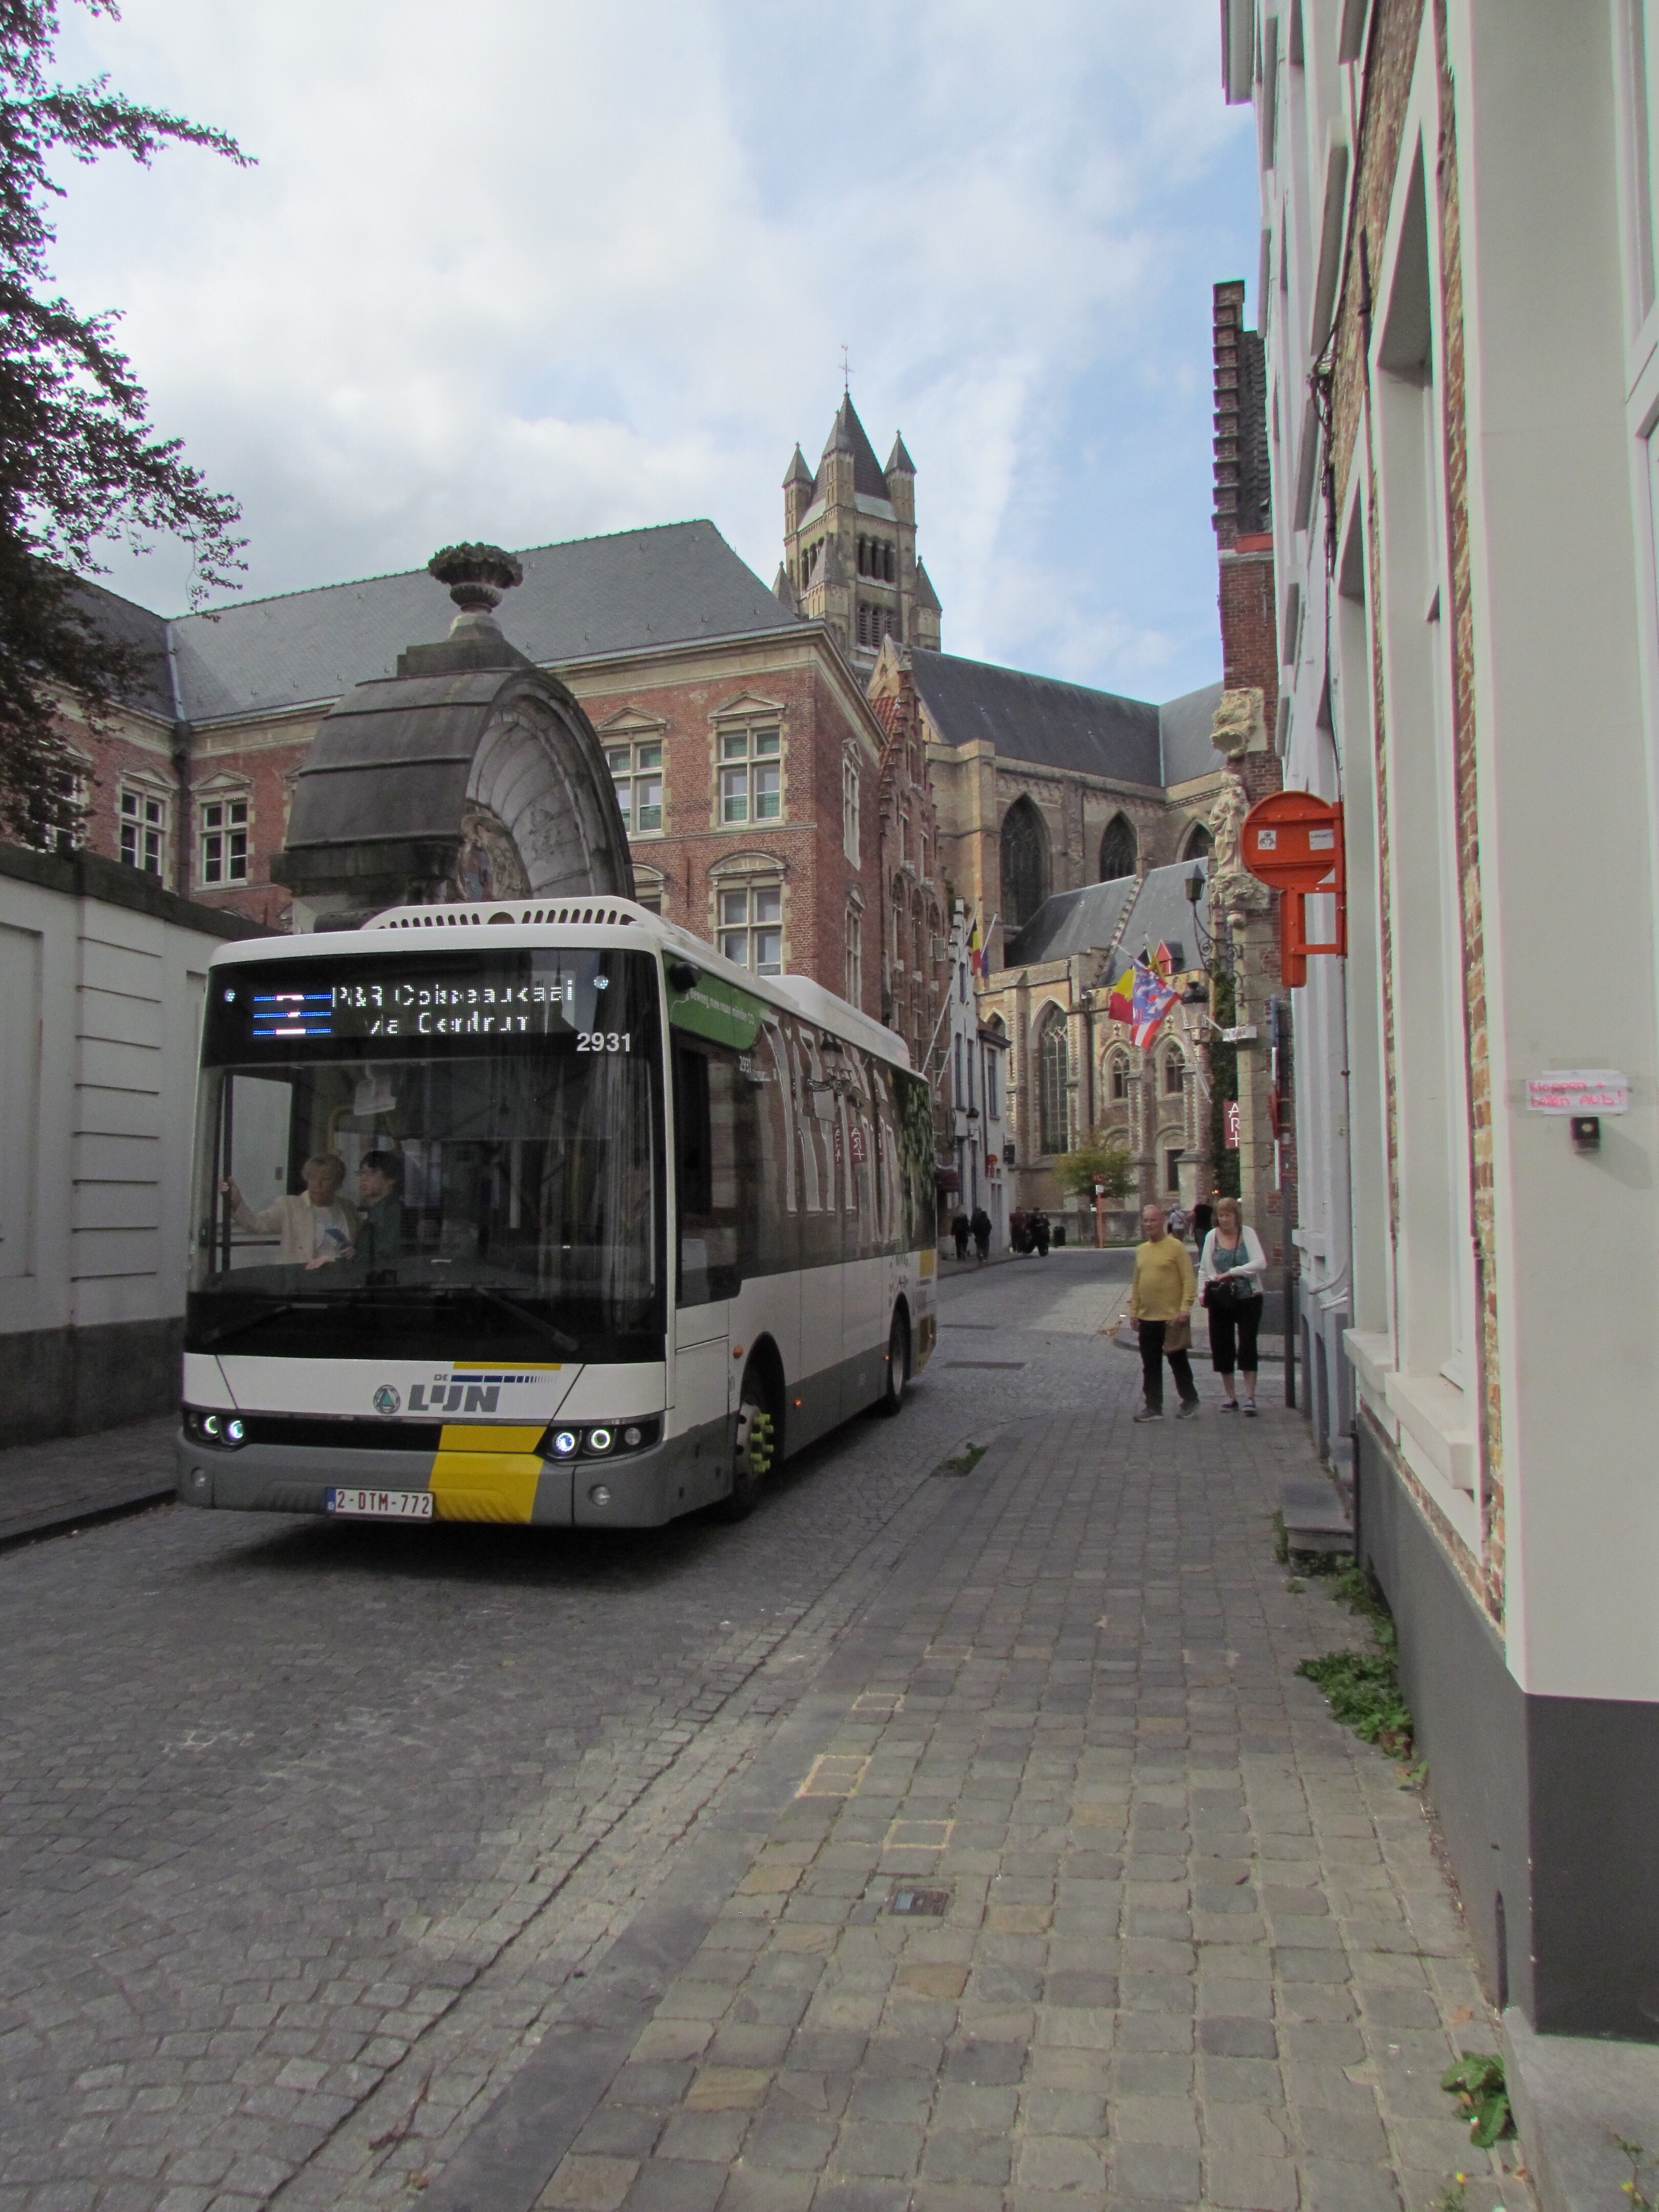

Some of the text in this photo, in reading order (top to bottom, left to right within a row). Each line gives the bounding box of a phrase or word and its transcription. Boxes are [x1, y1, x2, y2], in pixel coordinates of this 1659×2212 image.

[577, 1032, 630, 1052] 2931
[739, 1055, 752, 1073] 2931
[408, 1384, 501, 1412] LIJN
[337, 1491, 430, 1514] 2-DTM-772
